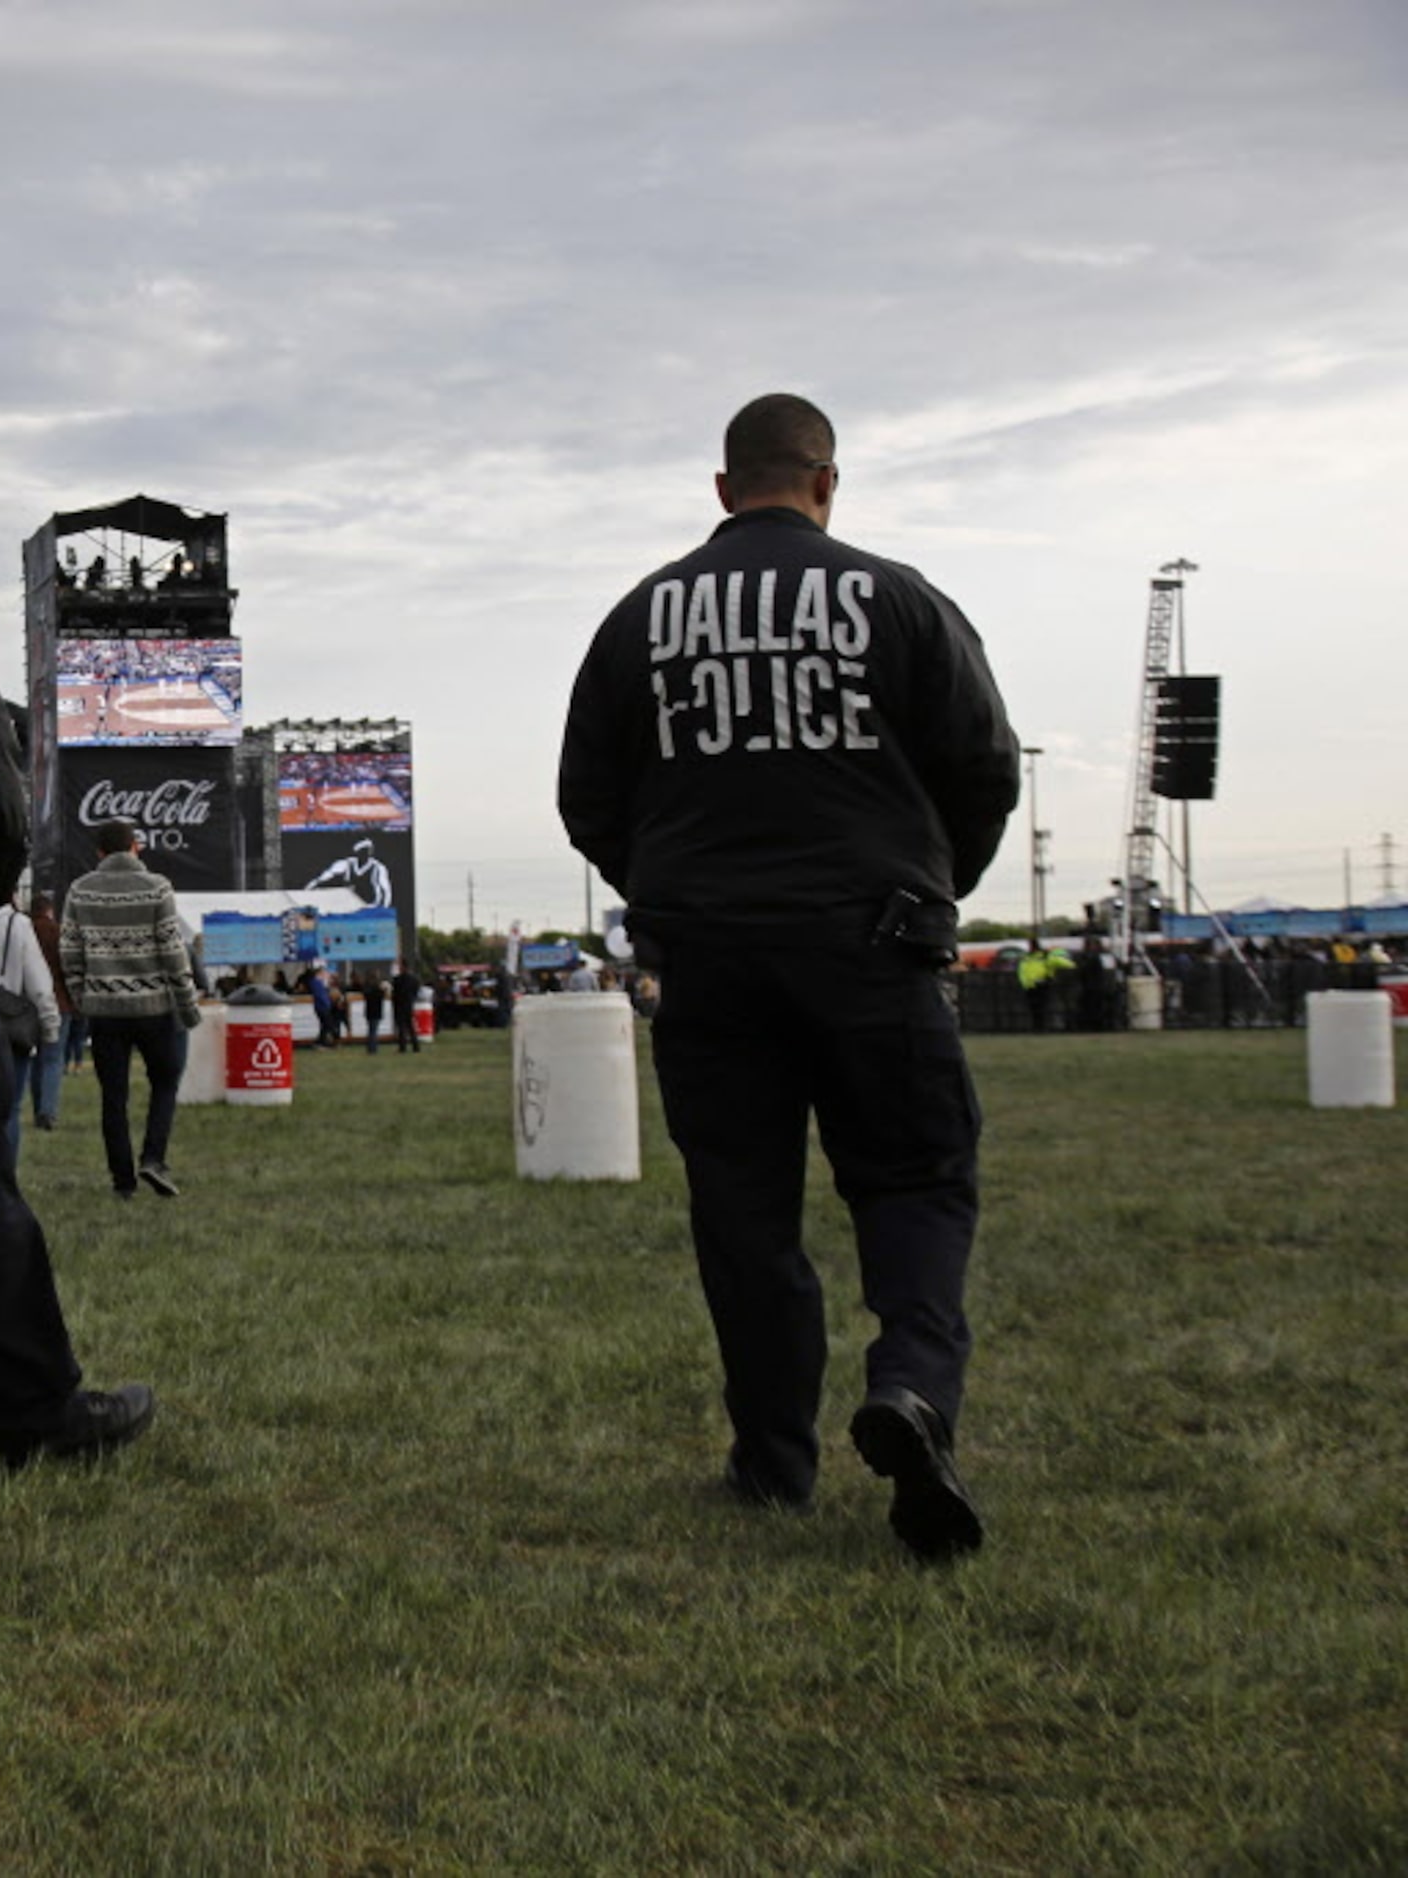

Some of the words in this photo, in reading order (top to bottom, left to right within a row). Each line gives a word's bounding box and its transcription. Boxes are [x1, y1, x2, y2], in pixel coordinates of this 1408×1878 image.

[648, 568, 874, 663] DALLAS
[78, 779, 219, 827] Coca-Cola
[133, 828, 189, 851] ero.
